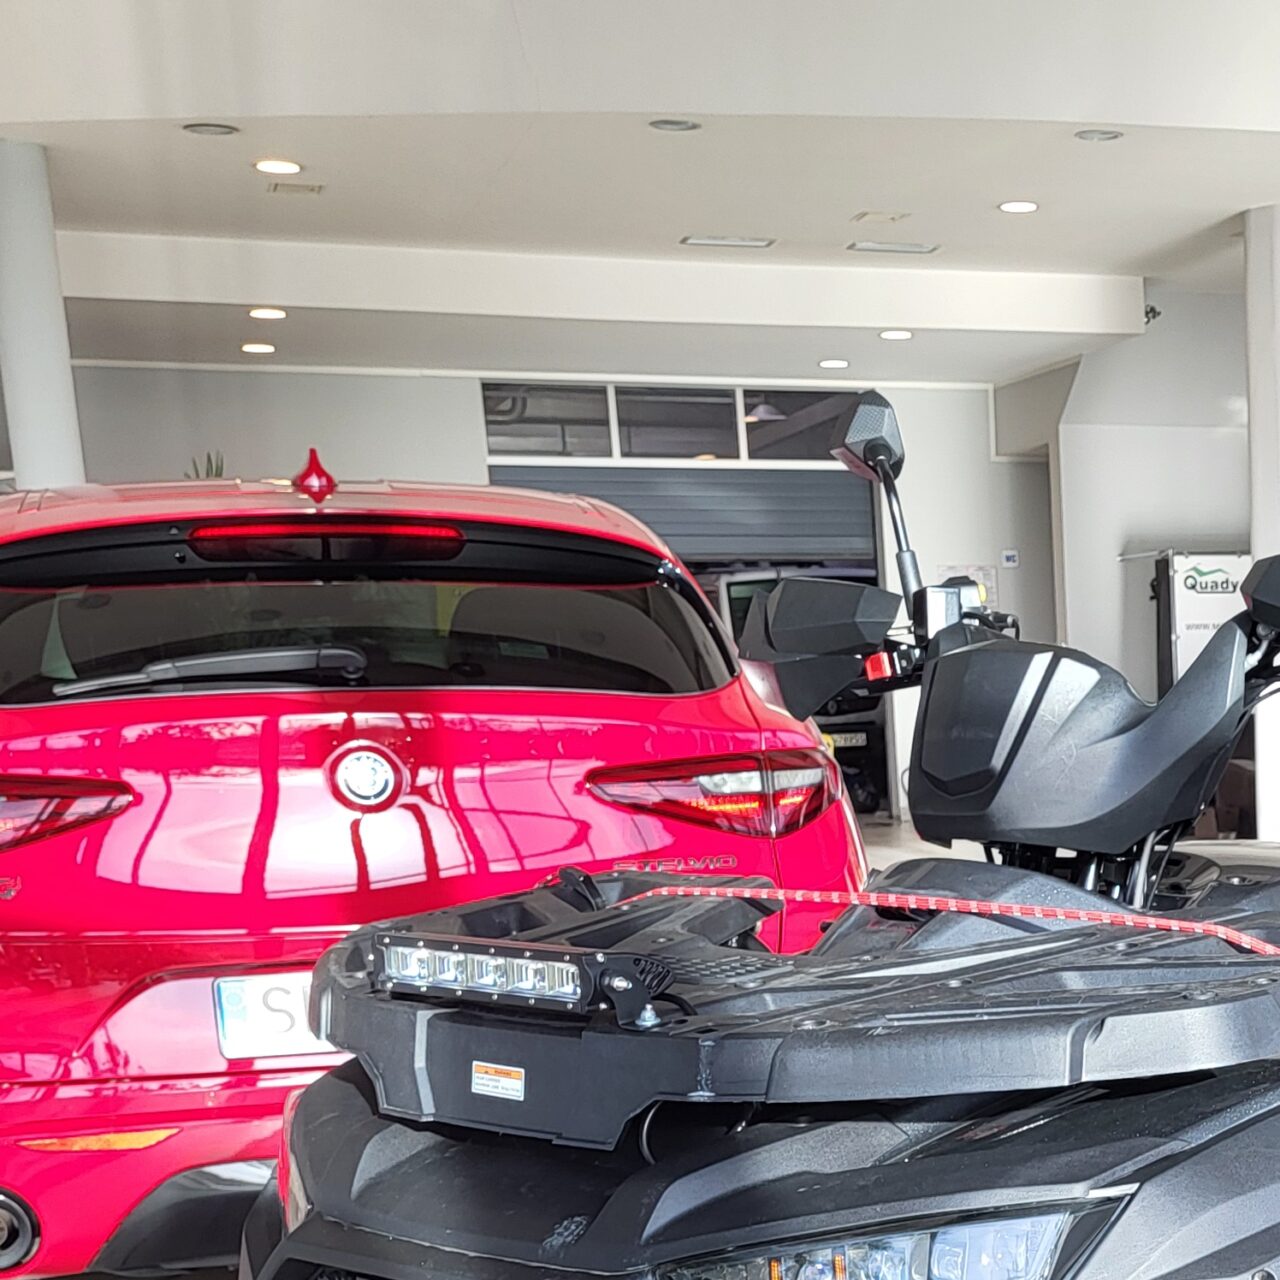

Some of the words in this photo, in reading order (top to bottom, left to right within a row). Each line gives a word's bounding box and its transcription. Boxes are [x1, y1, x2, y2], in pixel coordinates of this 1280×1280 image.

[1005, 554, 1017, 563] WC
[1184, 575, 1239, 594] Quady
[613, 855, 738, 872] STELVIO
[262, 986, 311, 1034] S
